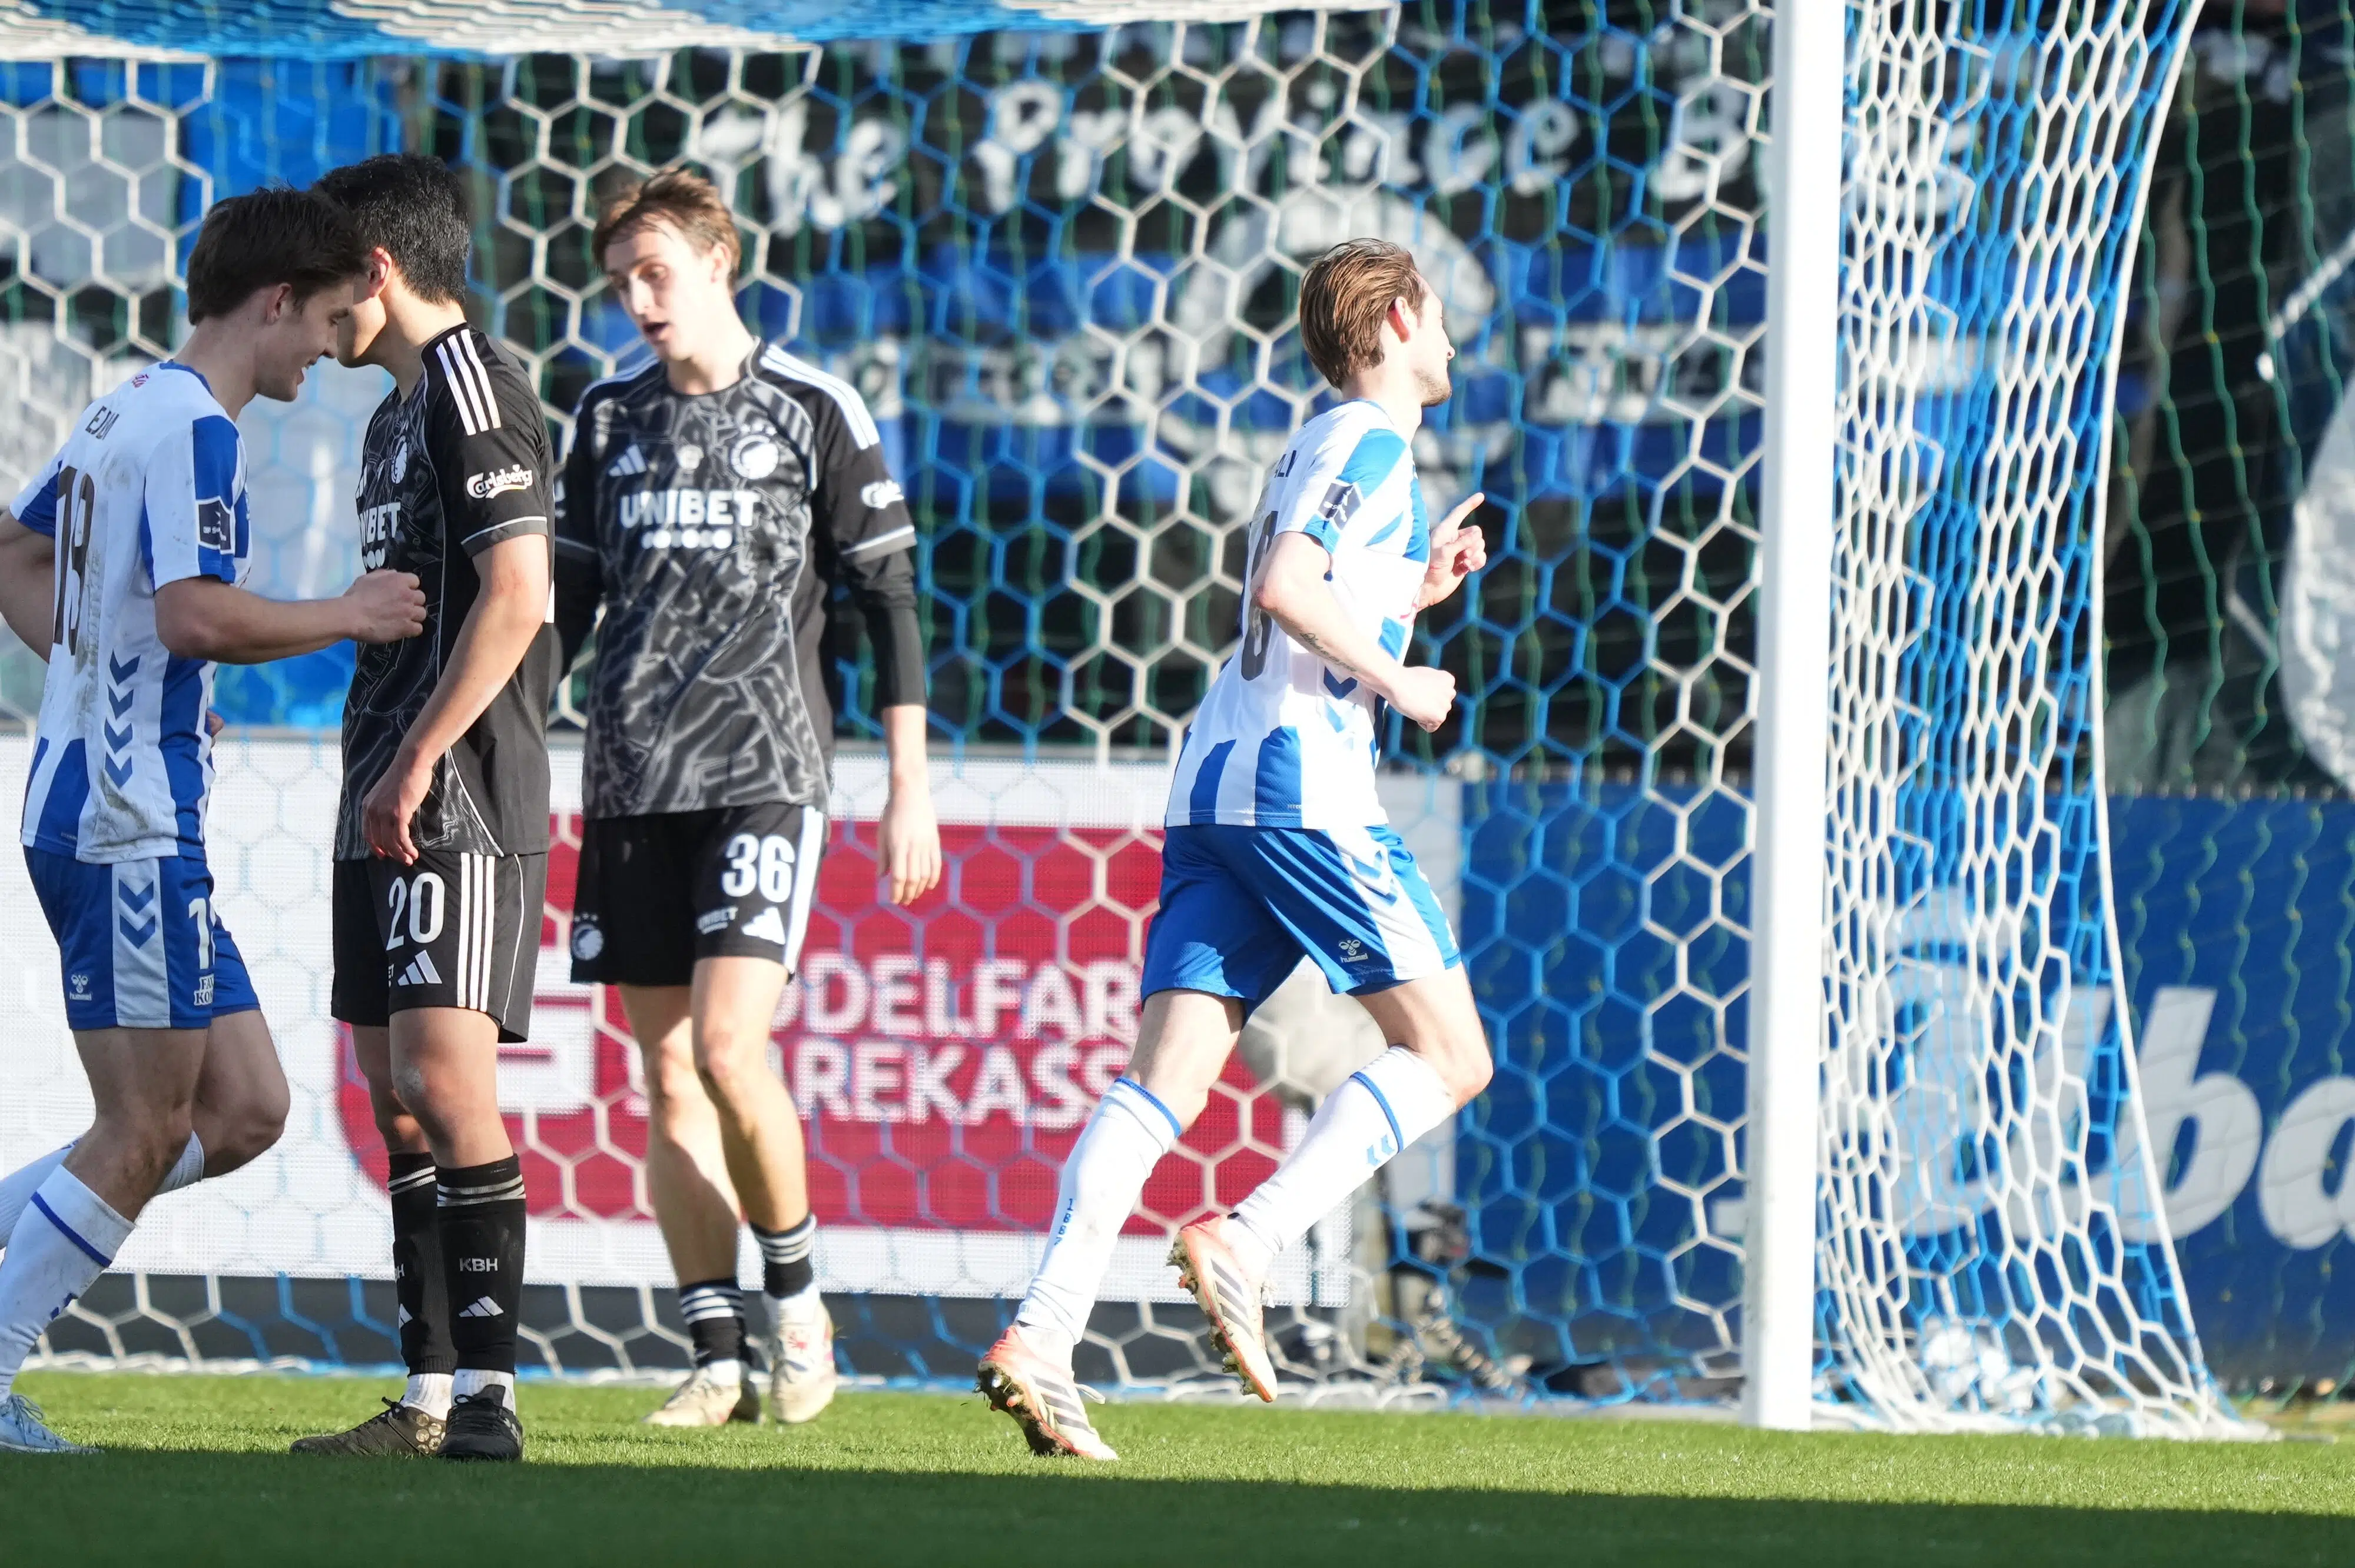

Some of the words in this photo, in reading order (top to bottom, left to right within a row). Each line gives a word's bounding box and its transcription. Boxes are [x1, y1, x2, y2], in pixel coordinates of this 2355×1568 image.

[467, 464, 532, 499] Carlsberg
[620, 489, 760, 528] UNIBET
[722, 833, 795, 903] 36
[188, 898, 216, 970] 1
[386, 872, 445, 951] 20
[459, 1257, 499, 1272] KBH
